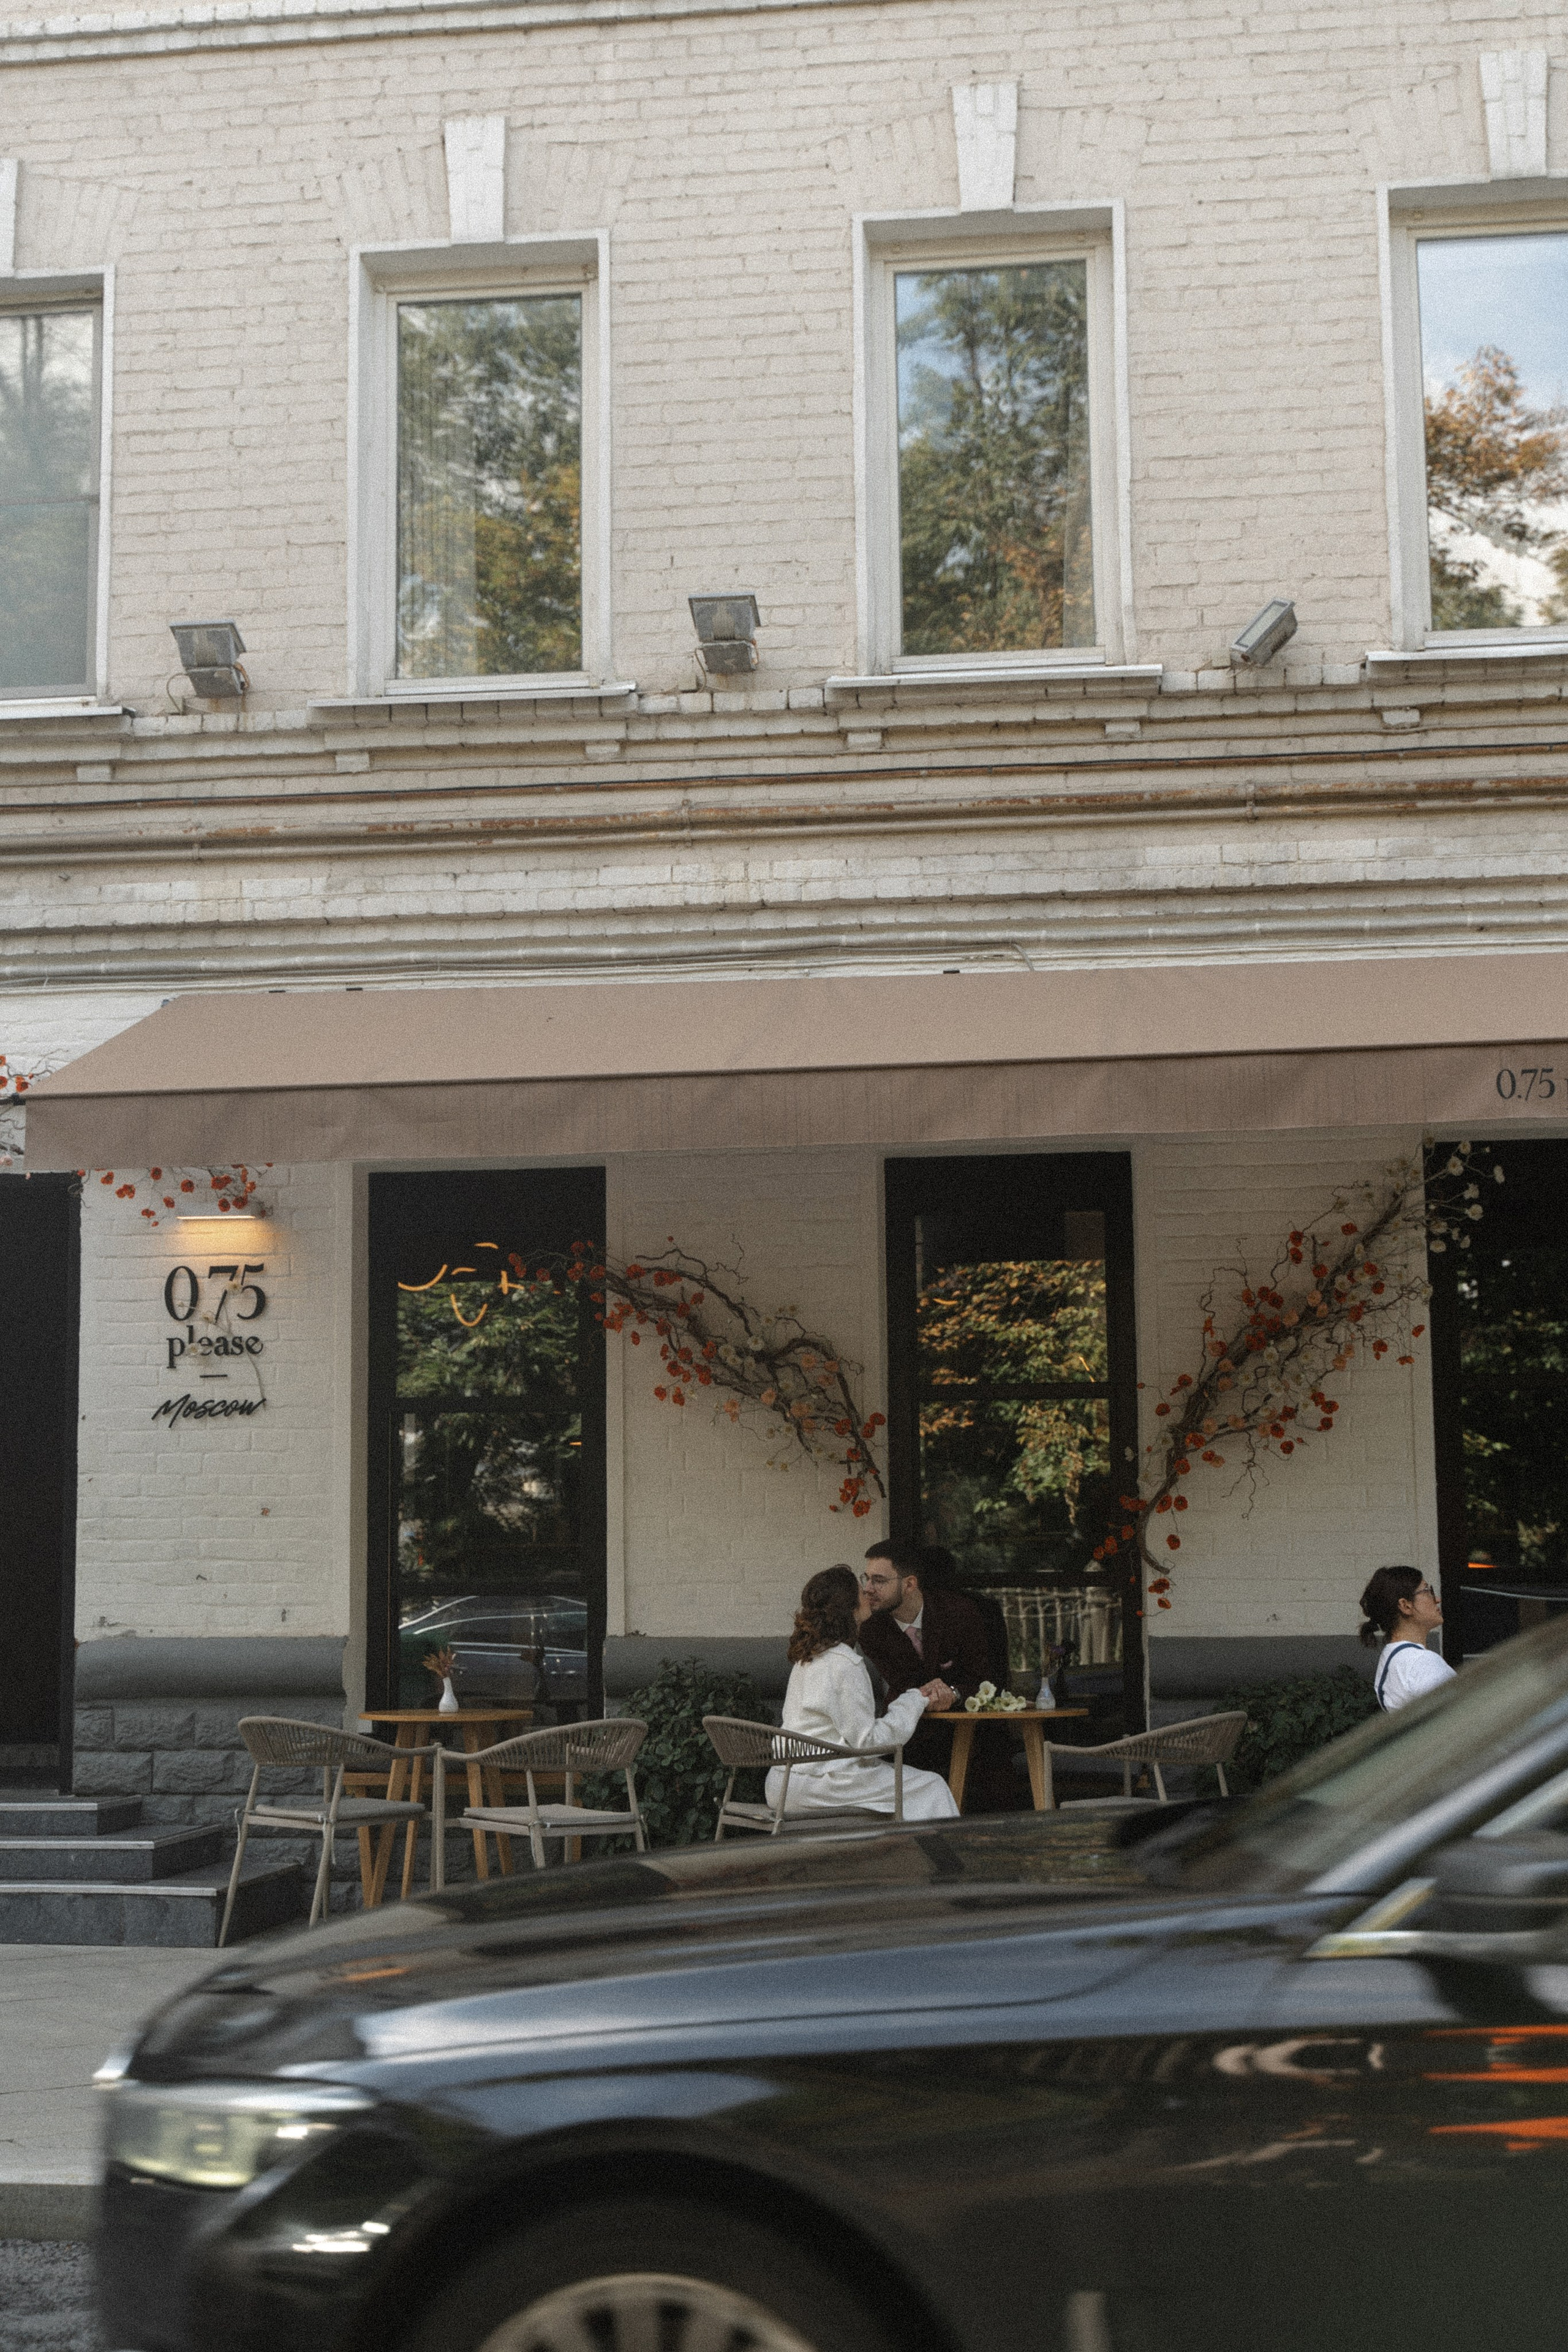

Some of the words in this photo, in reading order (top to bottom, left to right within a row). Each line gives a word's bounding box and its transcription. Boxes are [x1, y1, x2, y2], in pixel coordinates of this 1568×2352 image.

[1496, 1068, 1556, 1101] 0.75
[166, 1325, 263, 1369] please
[151, 1393, 266, 1428] Moscow
